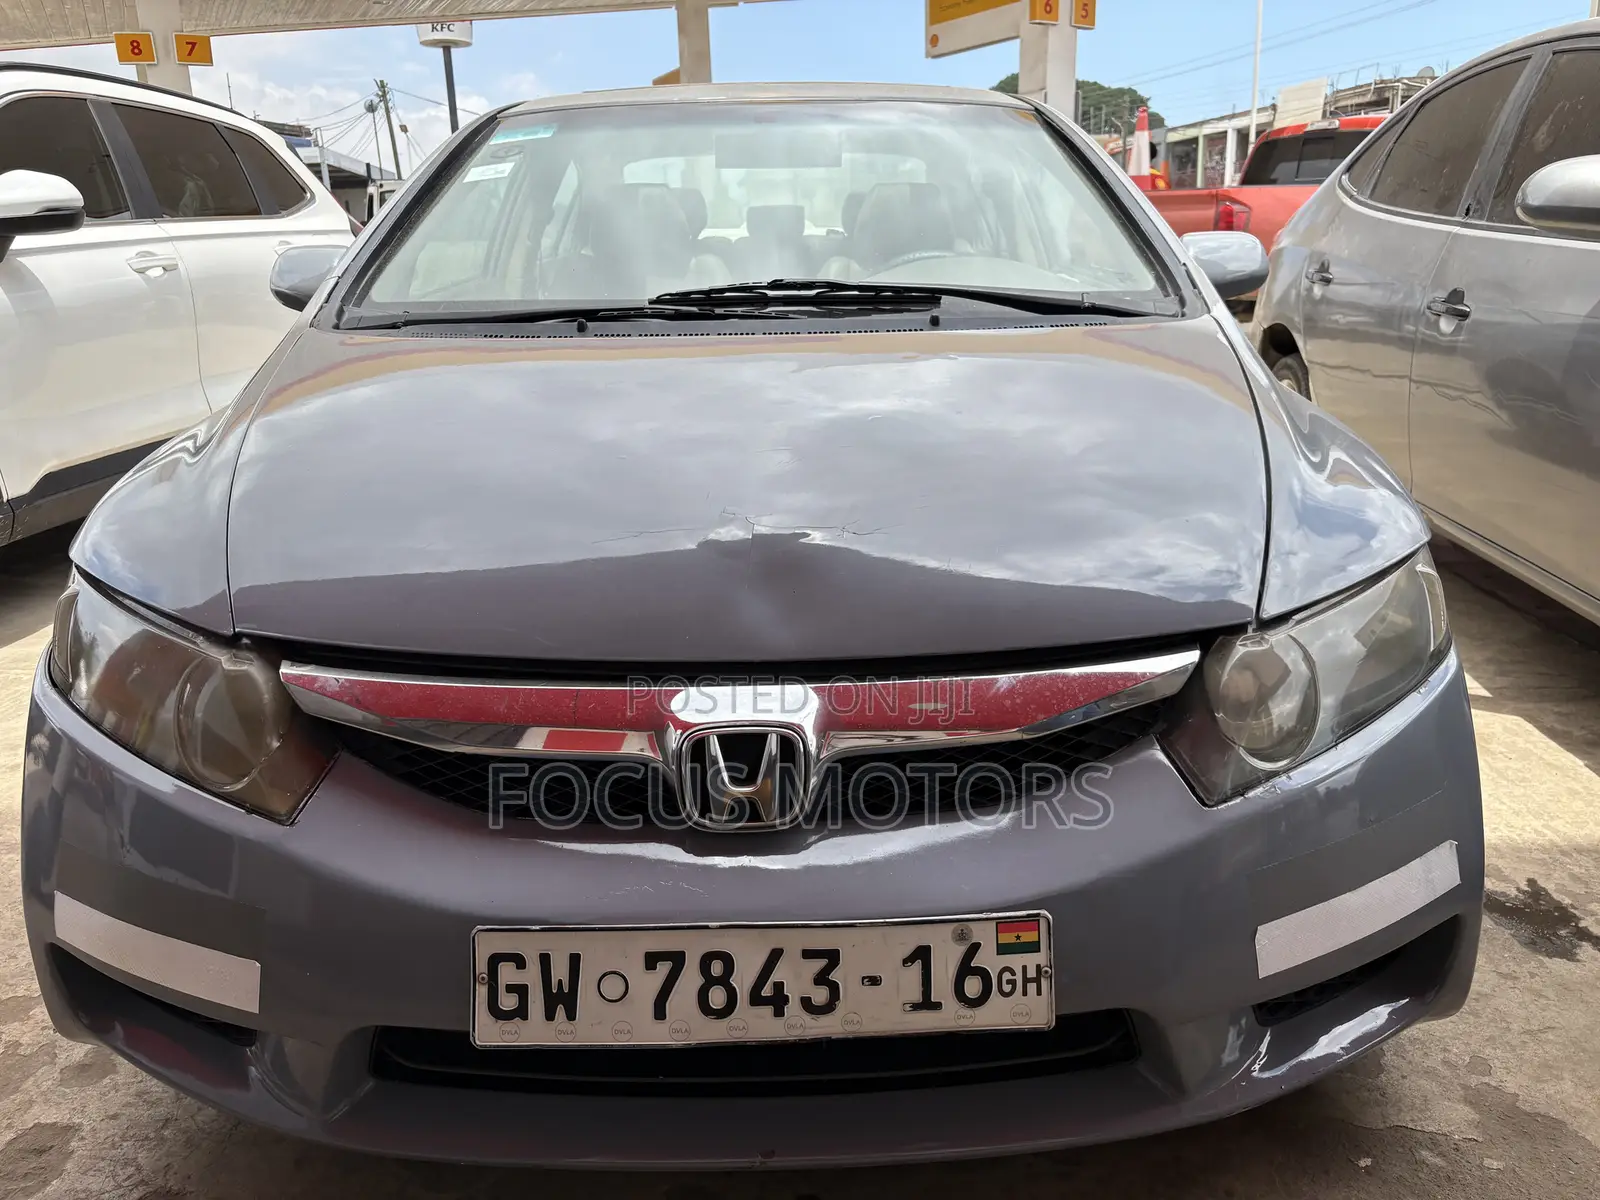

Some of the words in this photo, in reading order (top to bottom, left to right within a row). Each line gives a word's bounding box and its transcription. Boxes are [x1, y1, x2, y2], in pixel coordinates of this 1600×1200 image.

[1044, 0, 1053, 14] 6
[1080, 3, 1089, 19] 5
[431, 23, 455, 32] KFC
[129, 39, 143, 57] 8
[185, 41, 198, 57] 7
[487, 952, 582, 1022] GW
[996, 963, 1044, 998] GH
